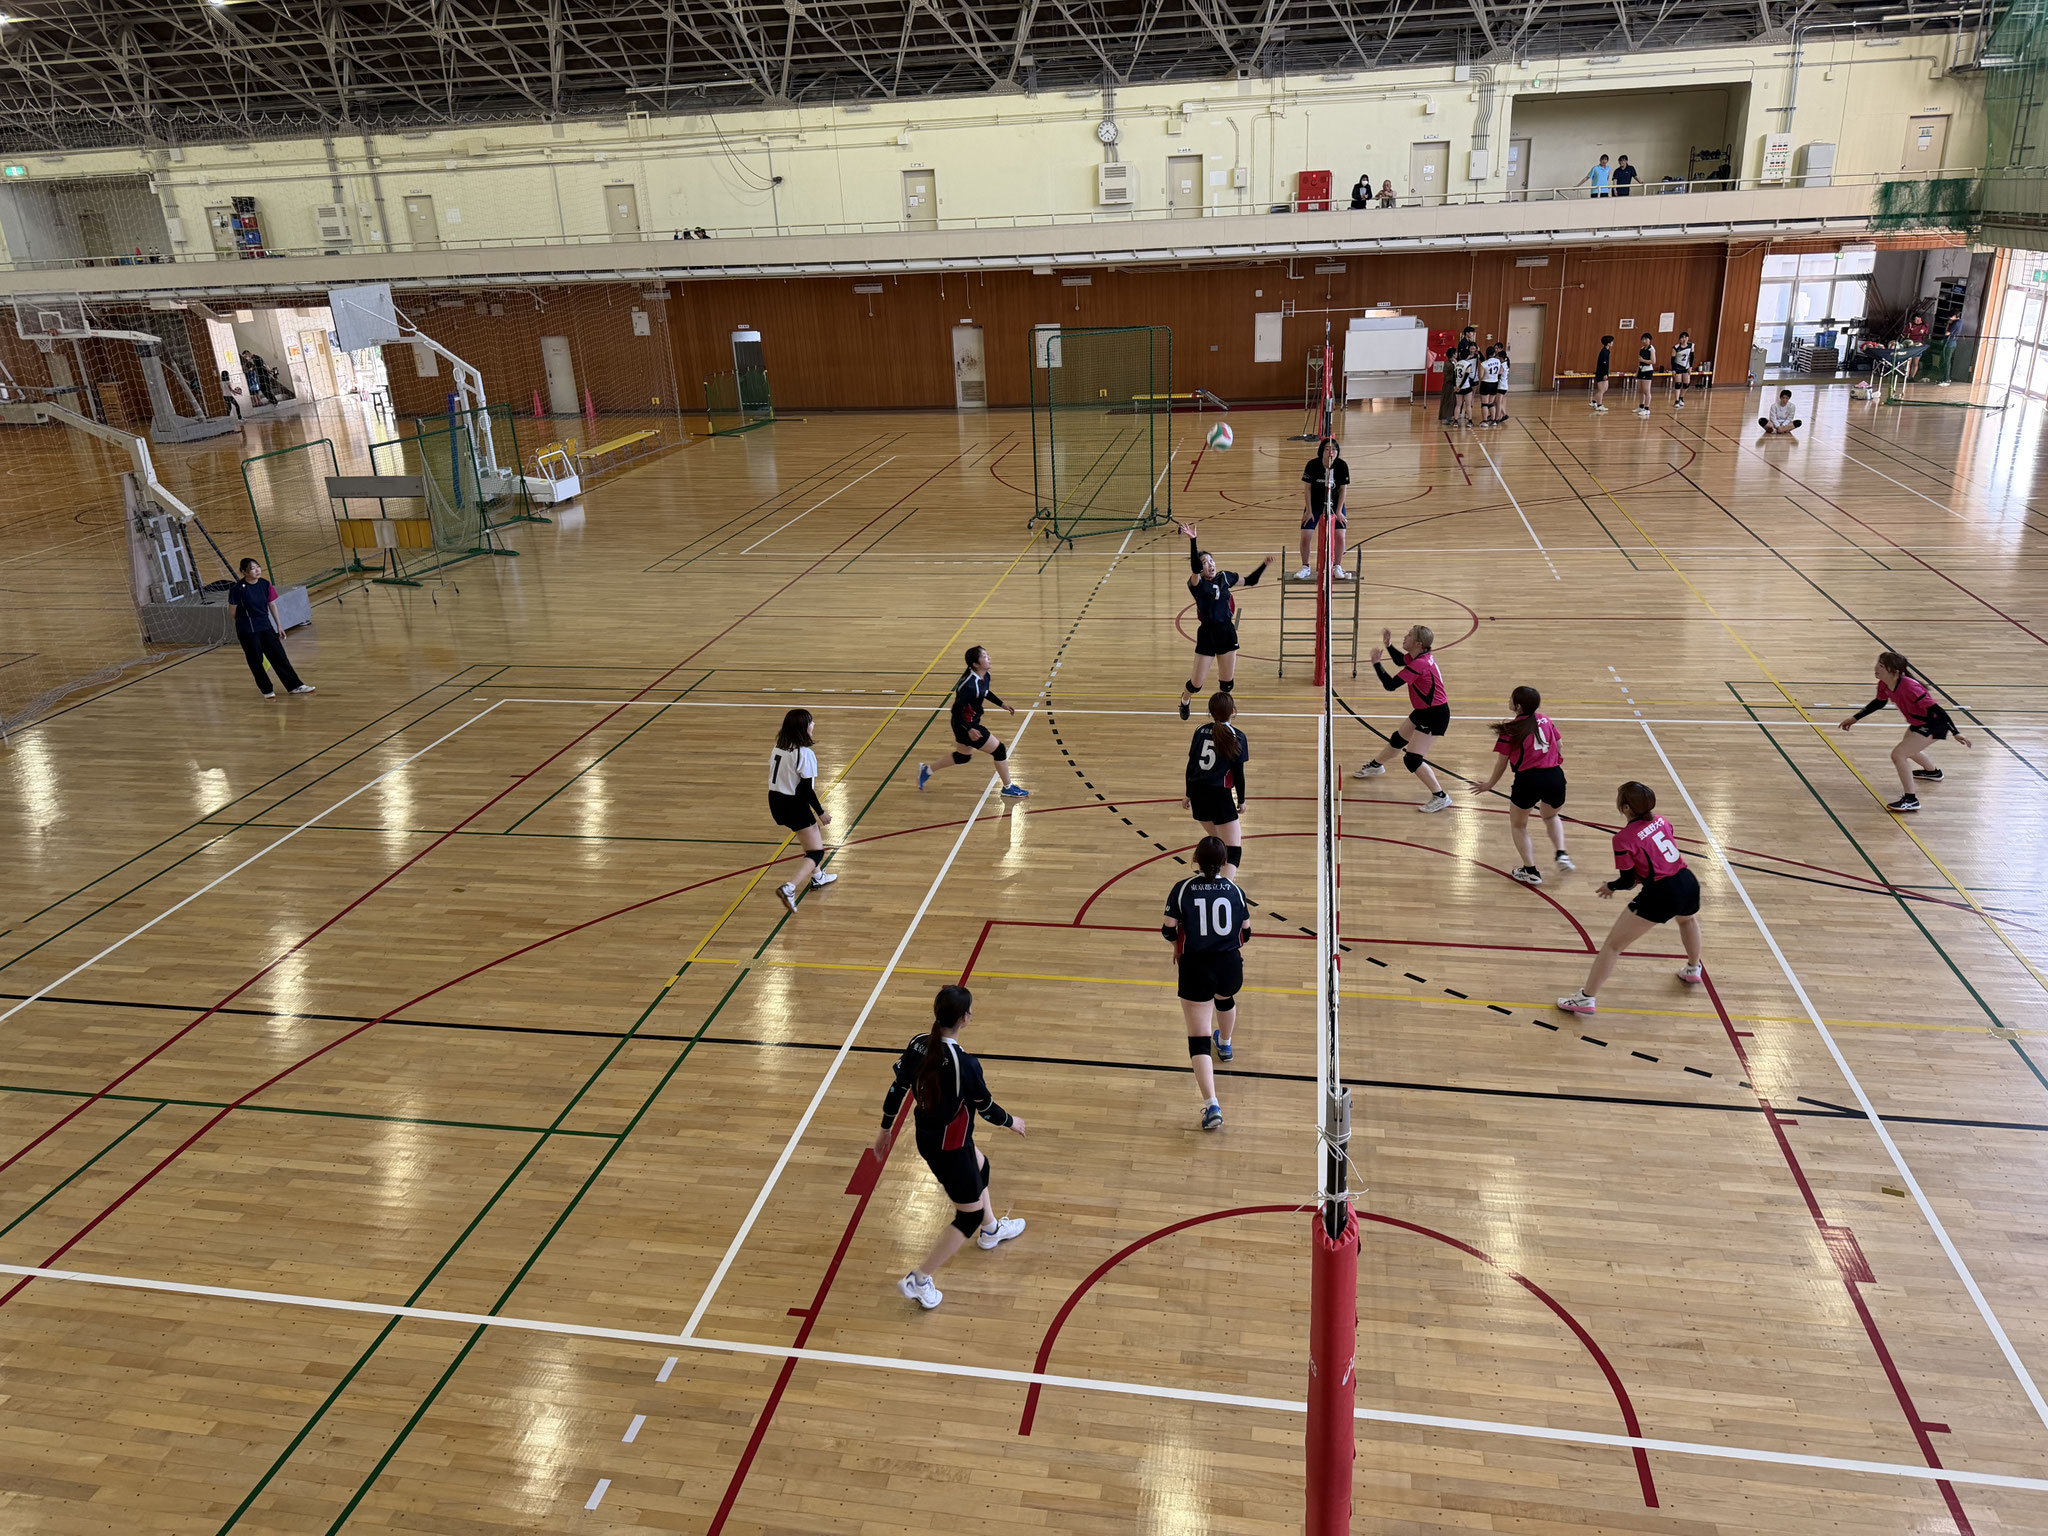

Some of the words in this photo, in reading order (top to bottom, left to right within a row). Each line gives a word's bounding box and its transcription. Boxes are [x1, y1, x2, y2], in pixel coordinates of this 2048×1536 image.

[1198, 739, 1217, 771] 5
[1533, 726, 1550, 754] 4
[772, 754, 782, 784] 1
[1651, 830, 1680, 864] 5
[1190, 883, 1232, 891] 東京都立大学
[1193, 896, 1233, 937] 10
